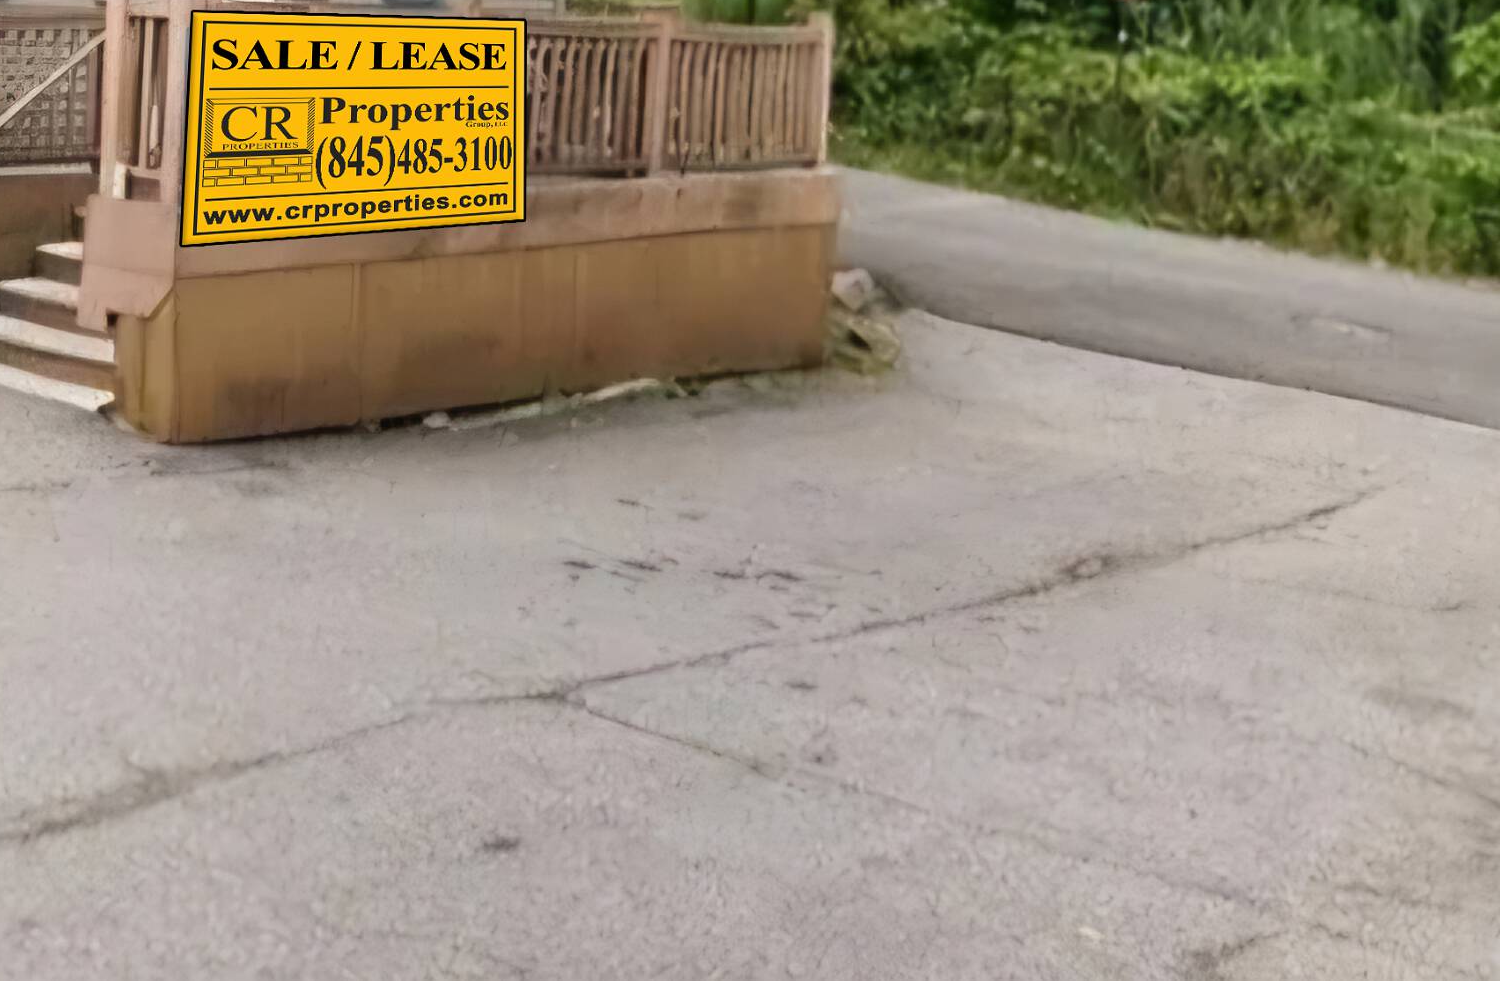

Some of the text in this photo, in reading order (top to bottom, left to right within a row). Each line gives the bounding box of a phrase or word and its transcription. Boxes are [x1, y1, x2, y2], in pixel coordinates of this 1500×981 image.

[211, 39, 339, 71] SALE
[370, 41, 508, 71] LEASE
[221, 105, 299, 142] CR
[319, 95, 510, 131] Properties
[222, 141, 300, 151] PROPERTIES
[203, 191, 509, 226] www.crproperties.com
